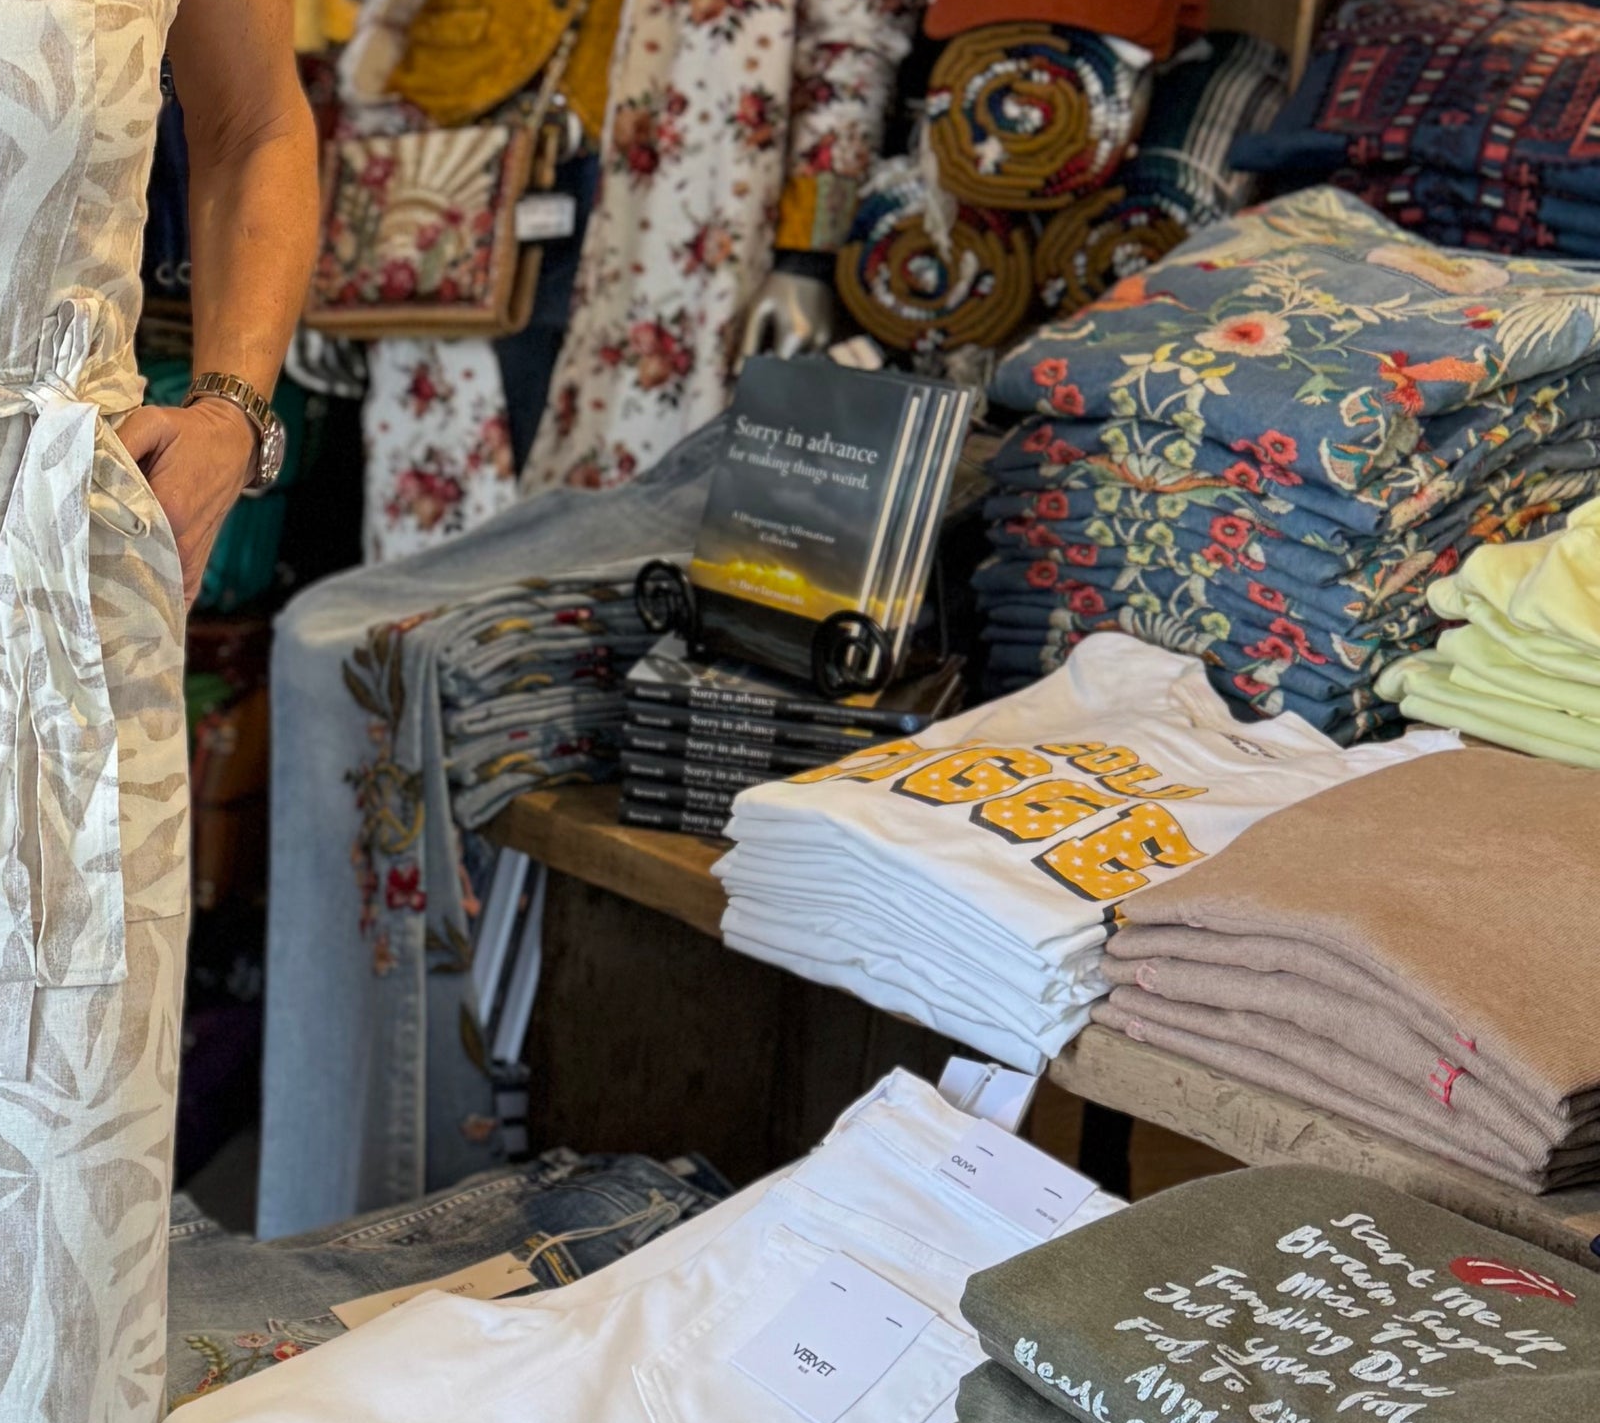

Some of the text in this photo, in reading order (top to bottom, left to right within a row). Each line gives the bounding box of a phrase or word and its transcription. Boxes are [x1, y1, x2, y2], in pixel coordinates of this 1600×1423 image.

[728, 444, 870, 490] for making things weird.
[734, 415, 878, 464] Sorry in advance
[690, 687, 777, 706] Sorry in advance
[1033, 741, 1209, 800] GOLD
[951, 1155, 977, 1175] OLIVIA
[1276, 1225, 1397, 1306] Brown
[1330, 1213, 1567, 1354] Start Me Up
[1143, 1281, 1236, 1328] Just
[1216, 1337, 1336, 1394] Your
[1195, 1264, 1354, 1357] Tumbling
[1276, 1272, 1448, 1364] Miss You
[793, 1342, 836, 1377] VERVET
[1114, 1316, 1210, 1363] Fool
[1198, 1354, 1252, 1393] To
